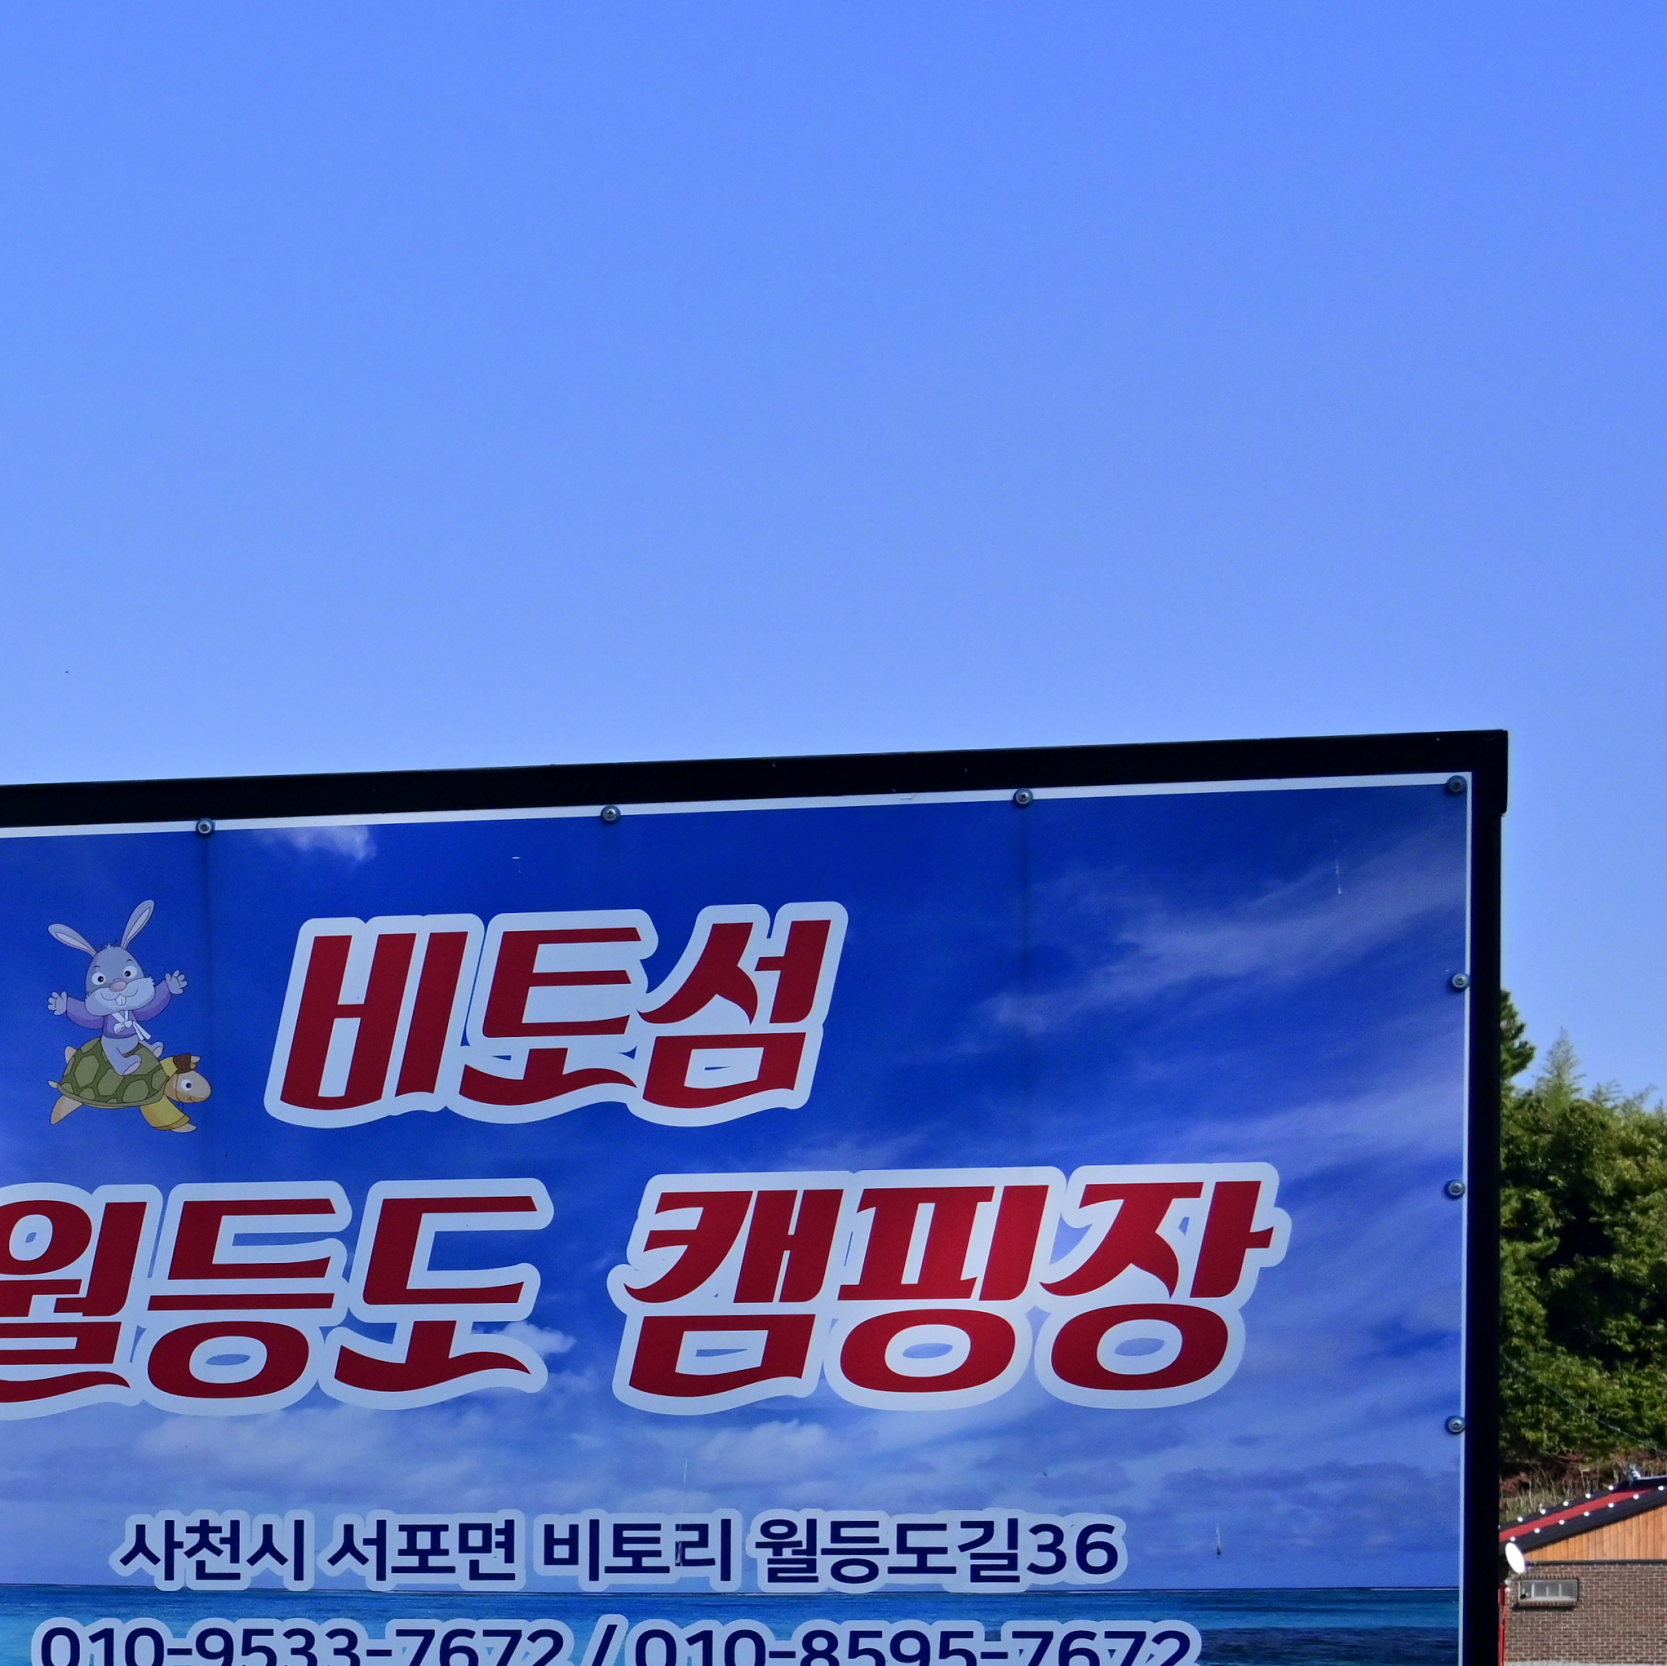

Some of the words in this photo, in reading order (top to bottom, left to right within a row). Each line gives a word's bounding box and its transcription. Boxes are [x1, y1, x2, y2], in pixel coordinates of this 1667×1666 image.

[281, 919, 832, 1111] 비토섬
[624, 1179, 1275, 1397] 캠핑장
[119, 1518, 305, 1582] 사천시
[326, 1518, 517, 1582] 서포면
[543, 1517, 733, 1583] 비토리
[754, 1517, 1120, 1585] 월등도길36
